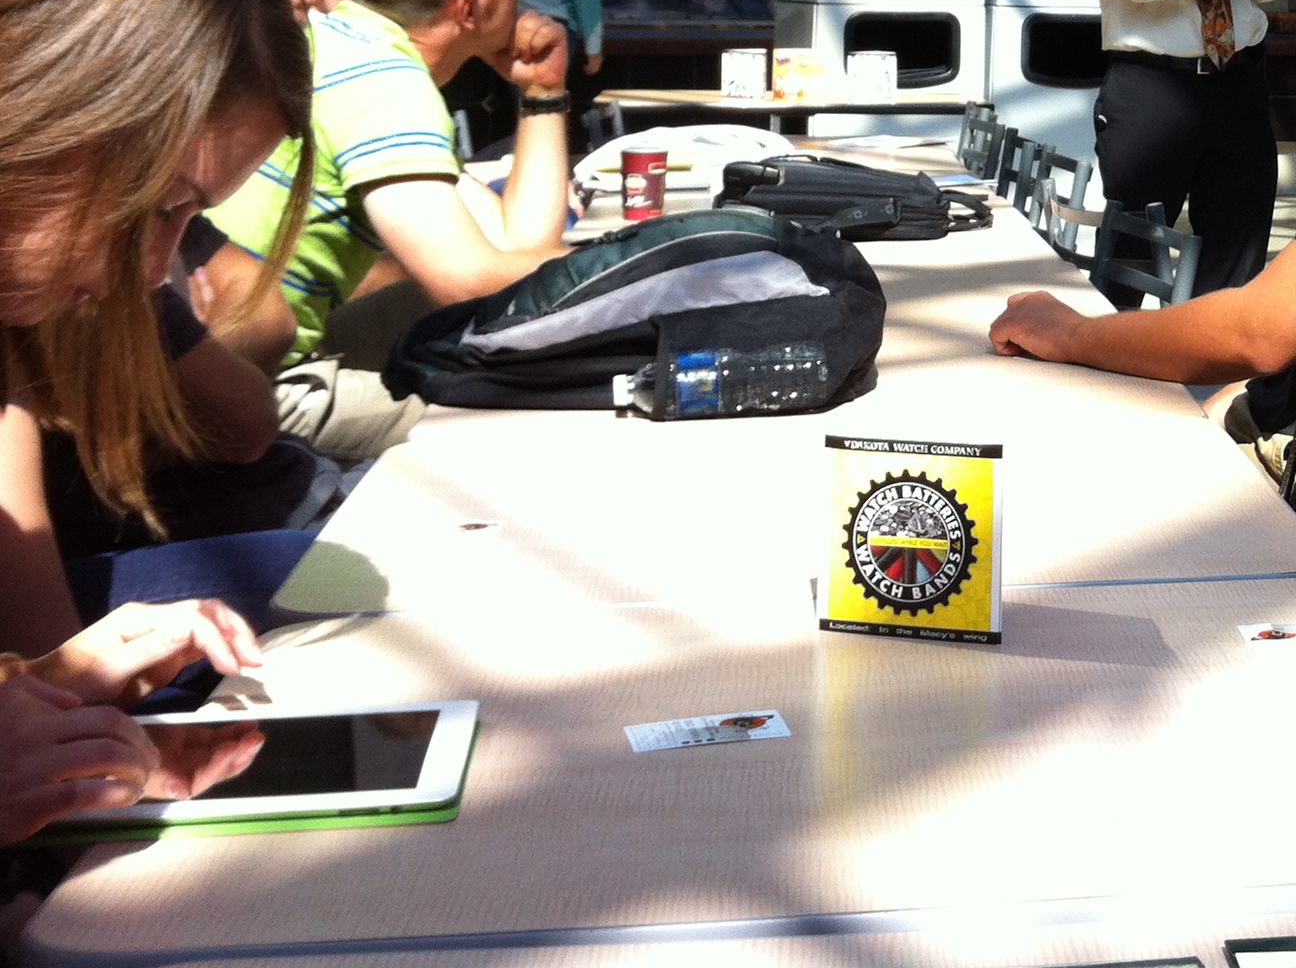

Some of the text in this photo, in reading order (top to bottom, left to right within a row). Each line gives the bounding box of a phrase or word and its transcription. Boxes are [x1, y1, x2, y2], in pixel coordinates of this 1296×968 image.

[850, 440, 982, 457] DAKOTA WATCH COMPANY
[857, 485, 961, 540] WATCH BATTERIES
[856, 544, 961, 600] WATCH BANDS
[896, 627, 913, 636] the
[919, 629, 955, 640] Macy's
[962, 634, 988, 643] wing
